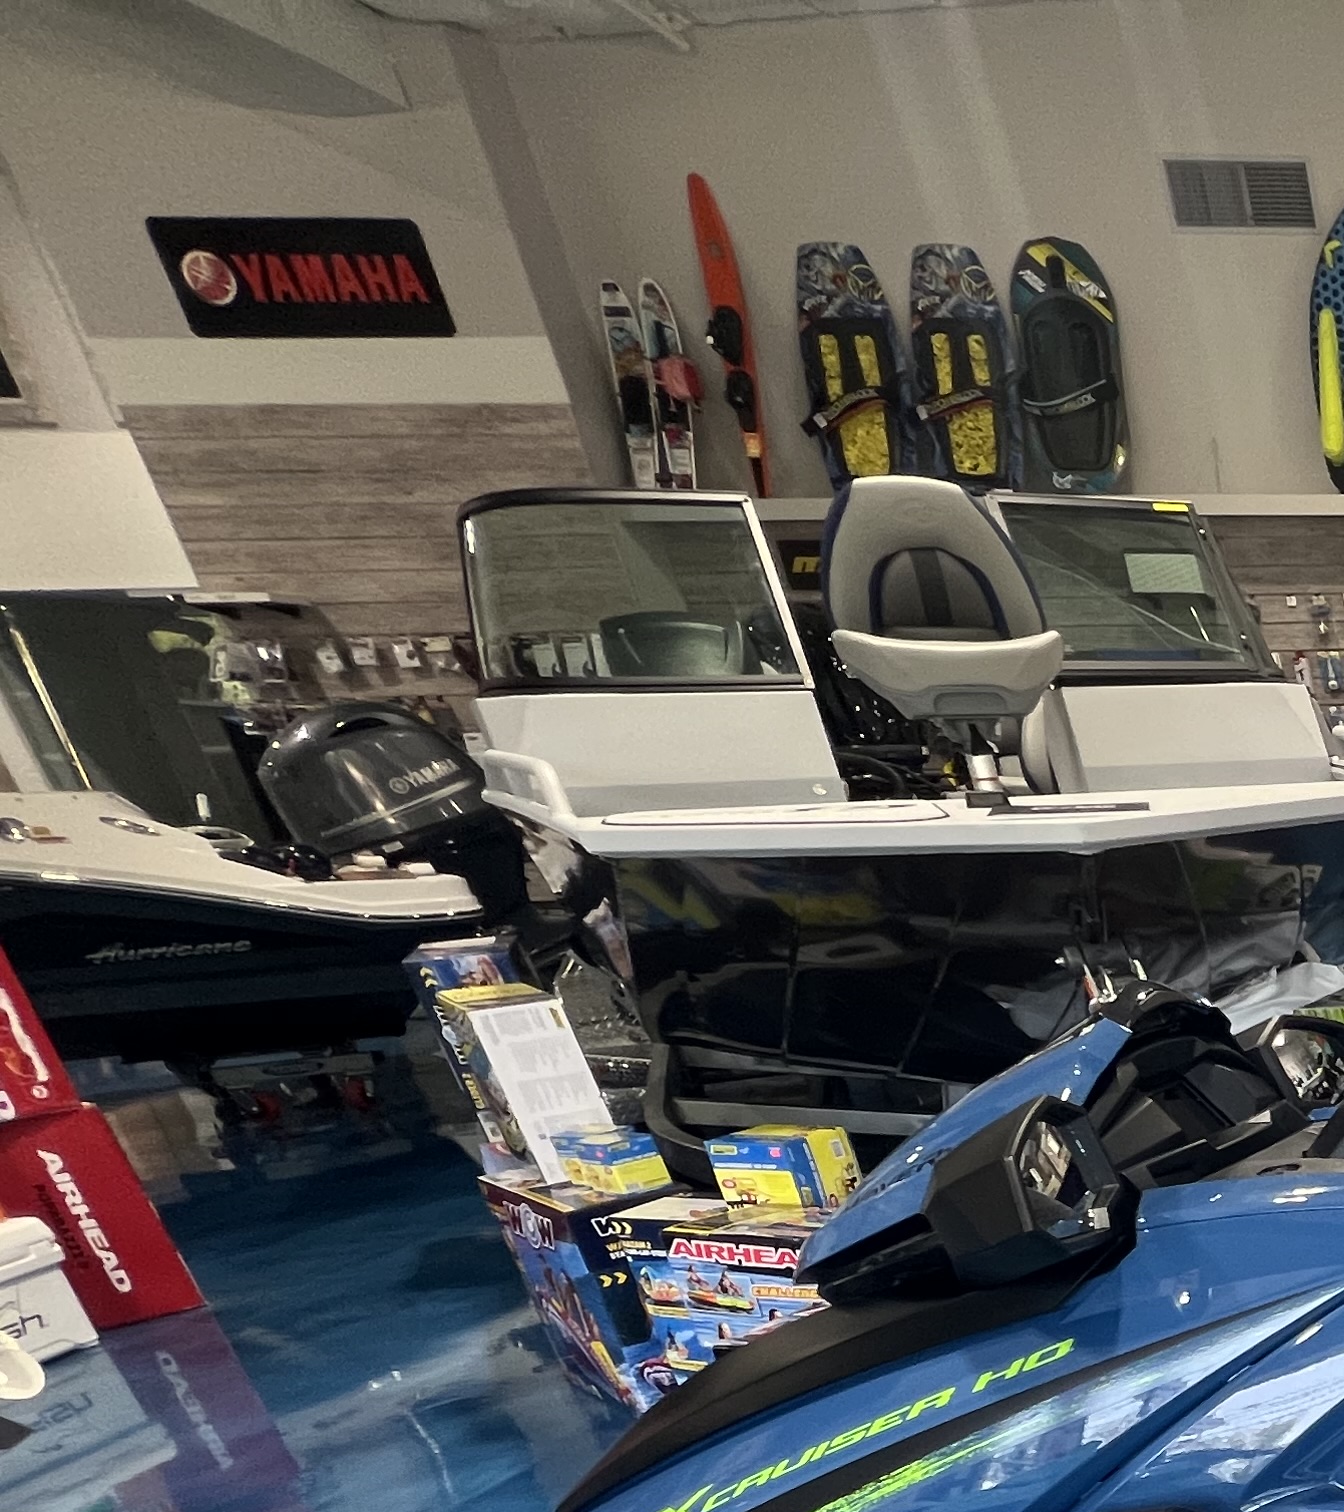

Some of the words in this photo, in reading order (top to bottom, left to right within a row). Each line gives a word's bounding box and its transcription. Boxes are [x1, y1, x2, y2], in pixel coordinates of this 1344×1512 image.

[231, 253, 431, 303] YAMAHA
[402, 758, 461, 788] YAMAHA
[37, 1149, 132, 1293] AIRHEAD
[669, 1238, 800, 1269] AIRHEA
[971, 1338, 1075, 1395] HO
